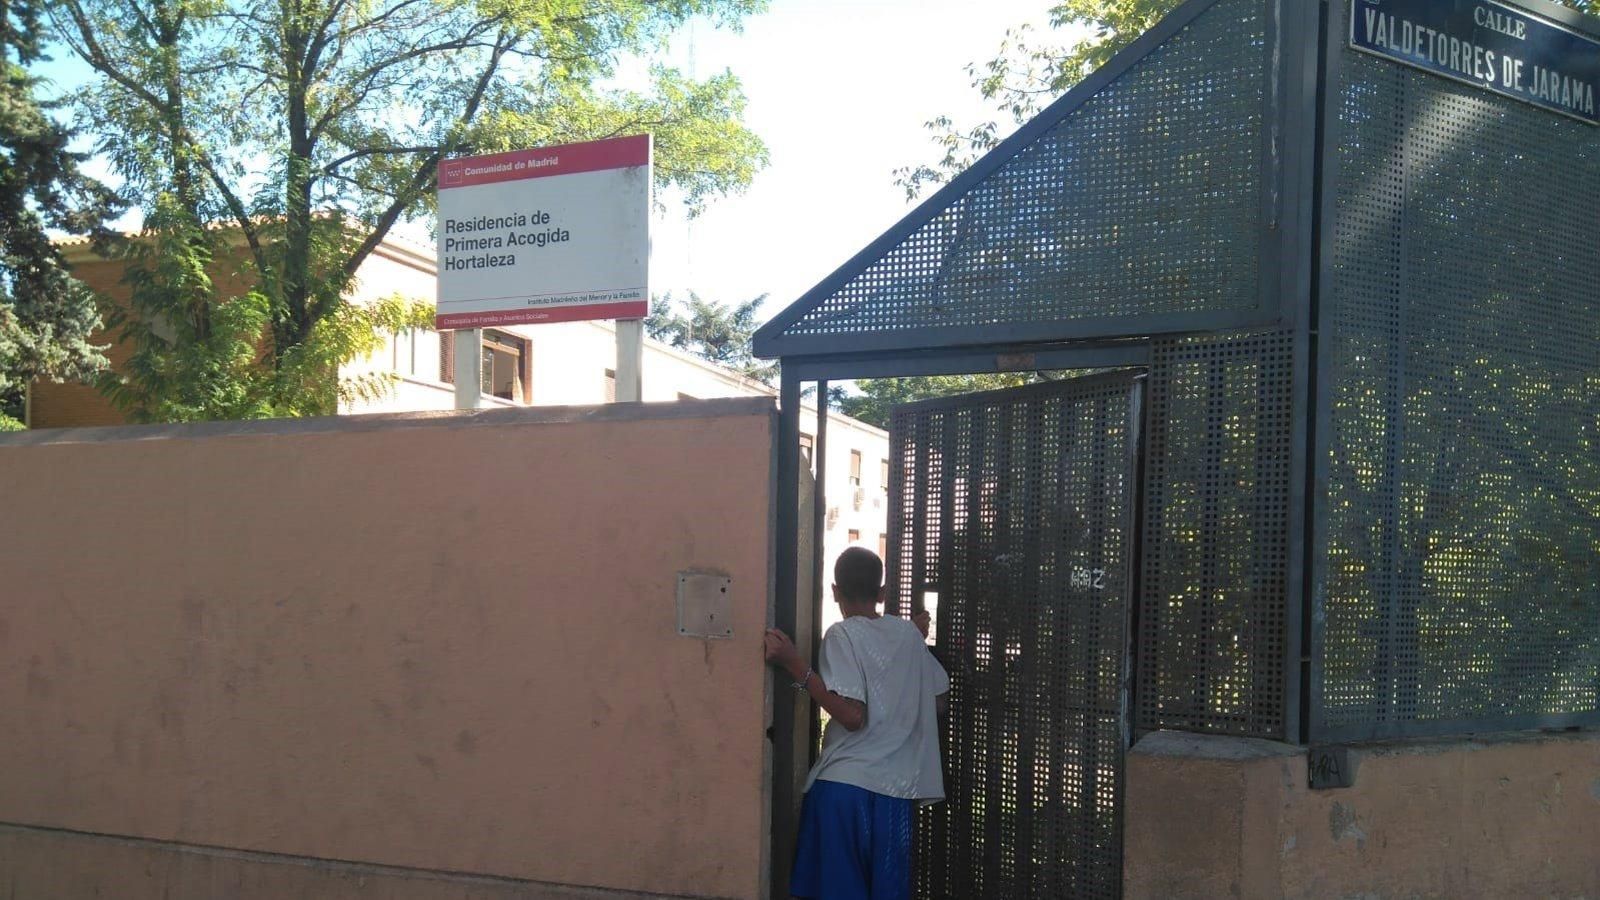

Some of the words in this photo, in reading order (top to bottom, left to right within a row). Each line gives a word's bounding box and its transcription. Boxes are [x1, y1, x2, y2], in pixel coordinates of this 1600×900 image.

[1474, 6, 1526, 40] CALLE
[1364, 8, 1496, 82] VALDETORRES
[1503, 55, 1524, 91] DE
[1529, 65, 1594, 114] JARAMA
[464, 161, 512, 176] Comunidad
[514, 160, 526, 170] de
[527, 156, 559, 169] Madrid
[445, 213, 526, 234] Residencia
[531, 210, 550, 225] de
[445, 235, 502, 252] Primera
[507, 228, 570, 247] Acogida
[445, 253, 516, 271] Hortaleza
